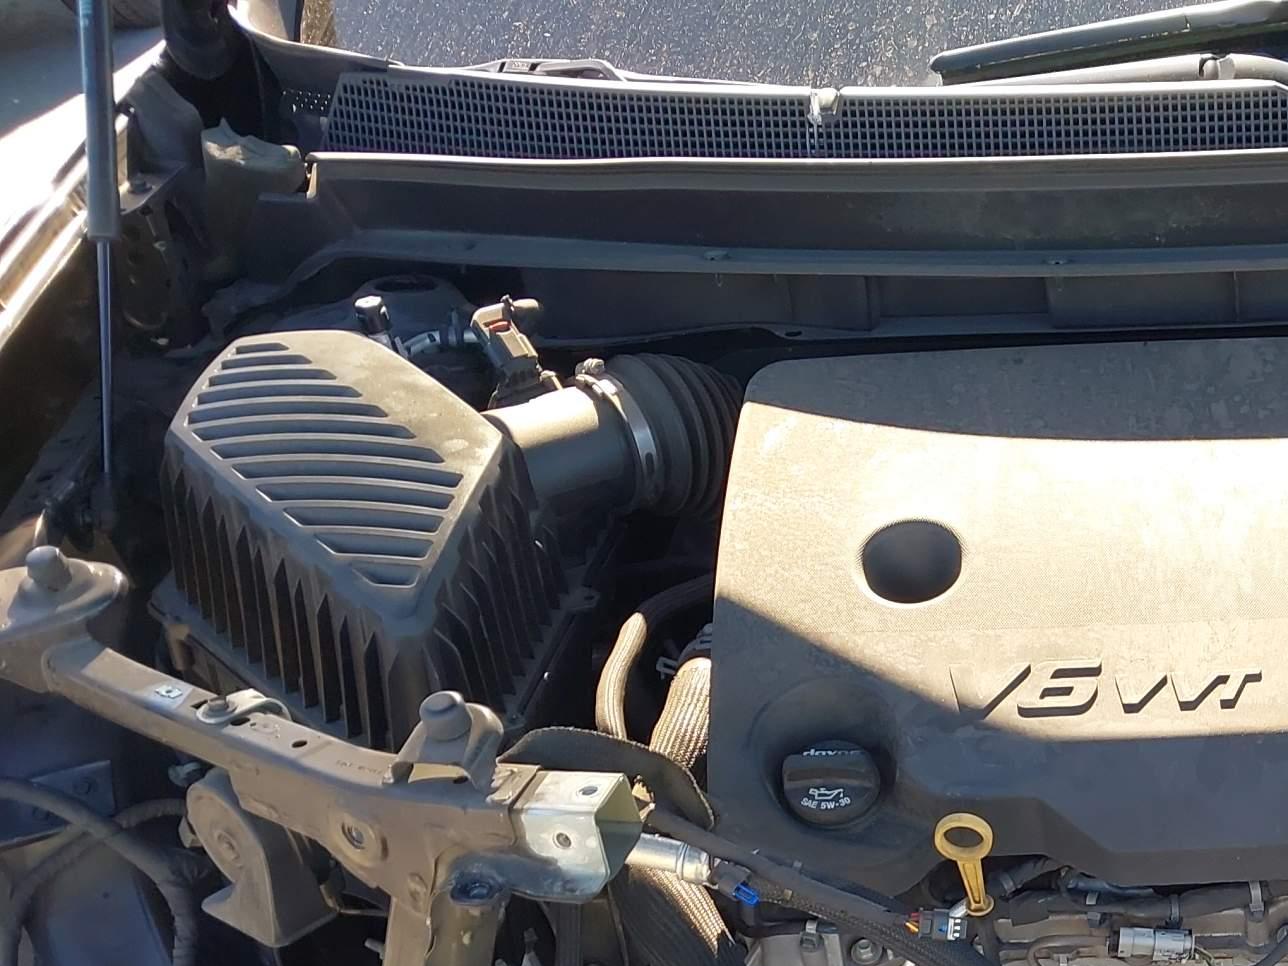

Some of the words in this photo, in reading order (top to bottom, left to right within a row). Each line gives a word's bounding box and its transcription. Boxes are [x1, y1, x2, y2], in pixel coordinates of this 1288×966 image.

[949, 658, 1102, 719] V6
[1114, 668, 1262, 714] VVT
[800, 797, 818, 809] SAE
[820, 797, 851, 810] 5W-30
